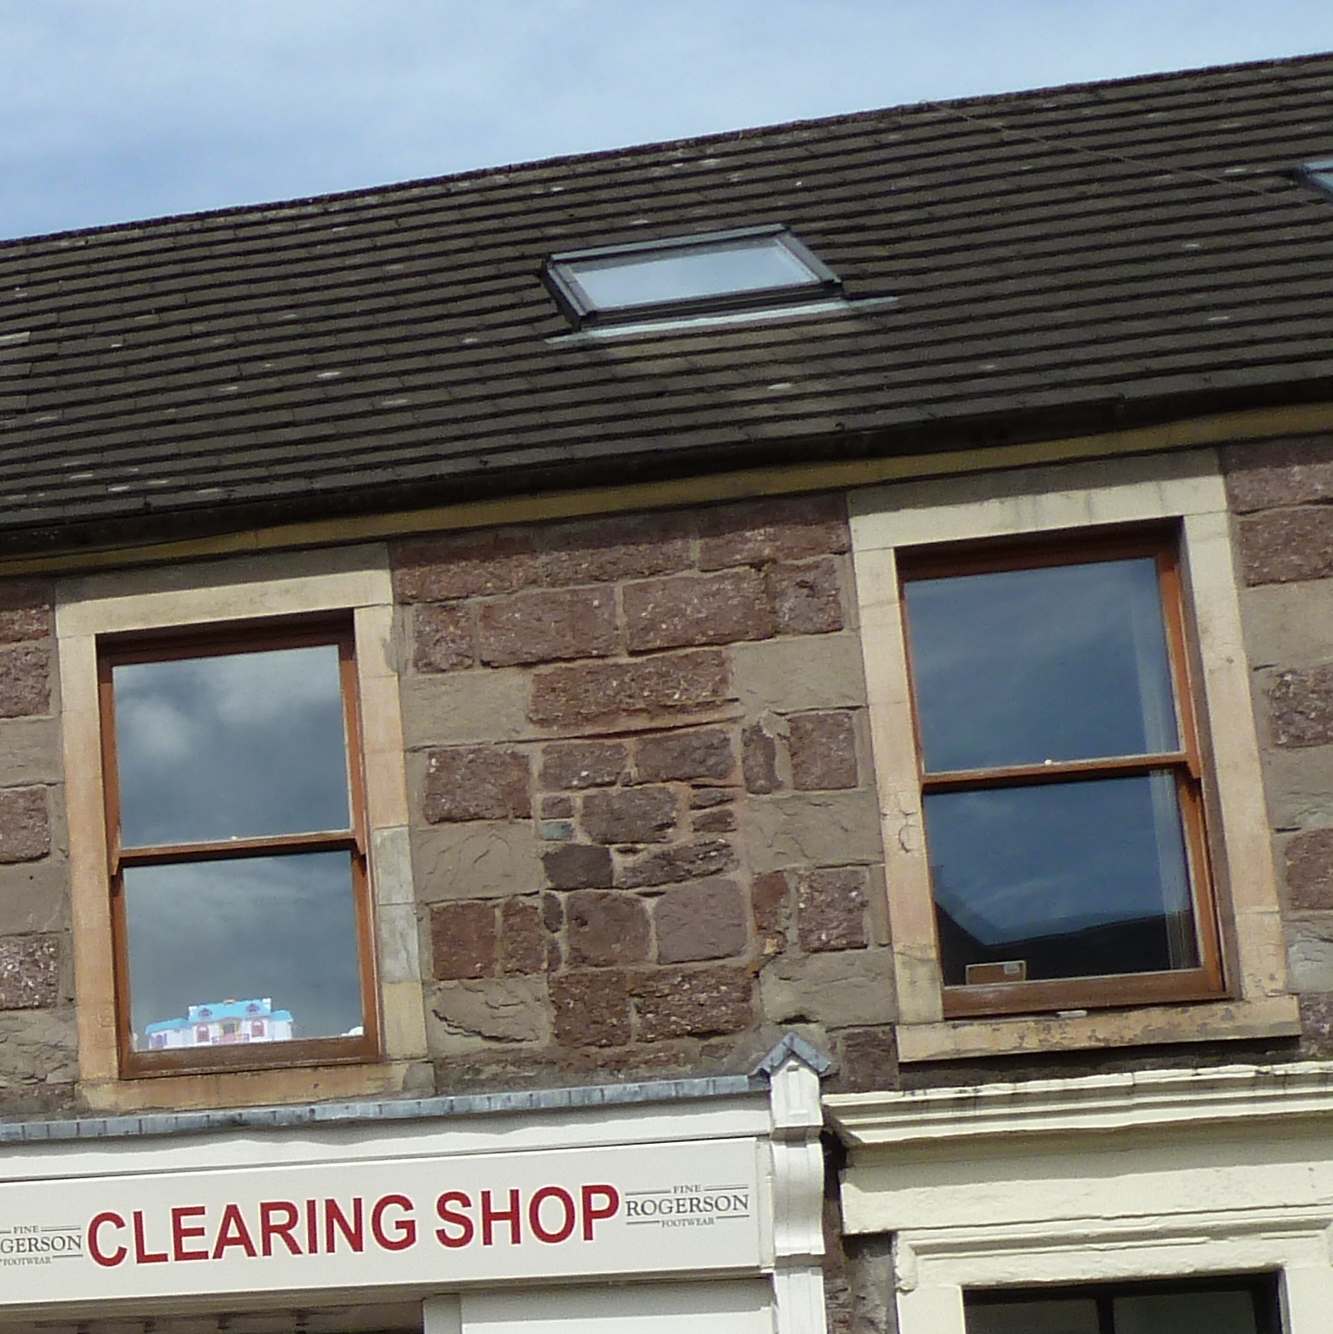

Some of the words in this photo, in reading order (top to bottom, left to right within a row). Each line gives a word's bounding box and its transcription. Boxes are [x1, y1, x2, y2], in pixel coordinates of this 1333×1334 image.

[673, 1184, 702, 1194] FINE
[625, 1194, 749, 1216] ROGERSON
[87, 1193, 417, 1268] CLEARING
[435, 1183, 620, 1249] SHOP
[661, 1217, 715, 1228] FOOTWEAR
[13, 1225, 39, 1234] FINE
[3, 1256, 52, 1266] FOOTWEAR
